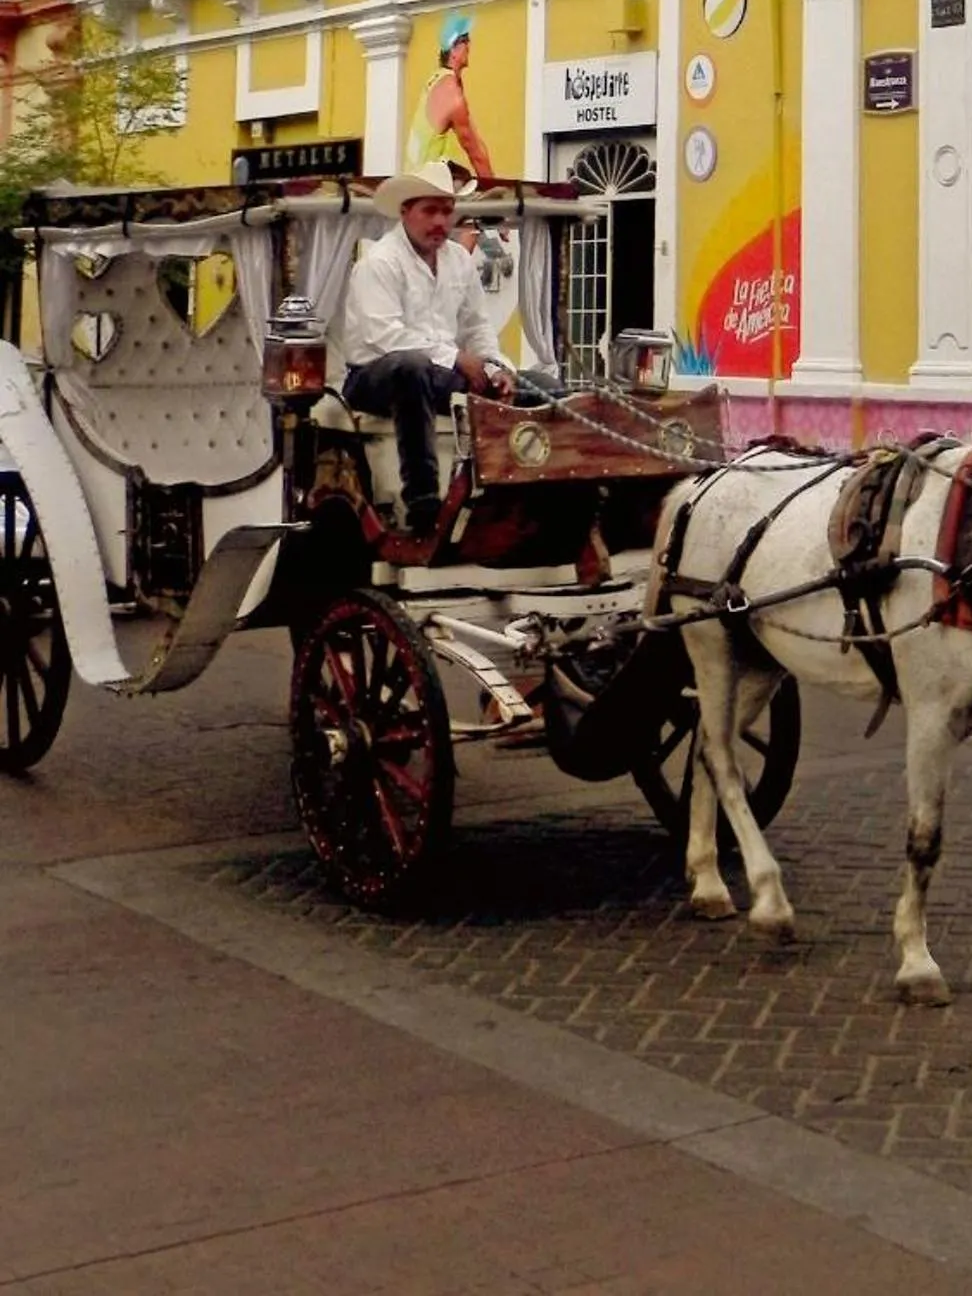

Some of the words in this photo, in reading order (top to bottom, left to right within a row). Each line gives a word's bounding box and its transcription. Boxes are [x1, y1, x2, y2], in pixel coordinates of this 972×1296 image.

[576, 106, 618, 123] HOSTEL
[733, 277, 748, 305] La
[723, 306, 738, 331] de
